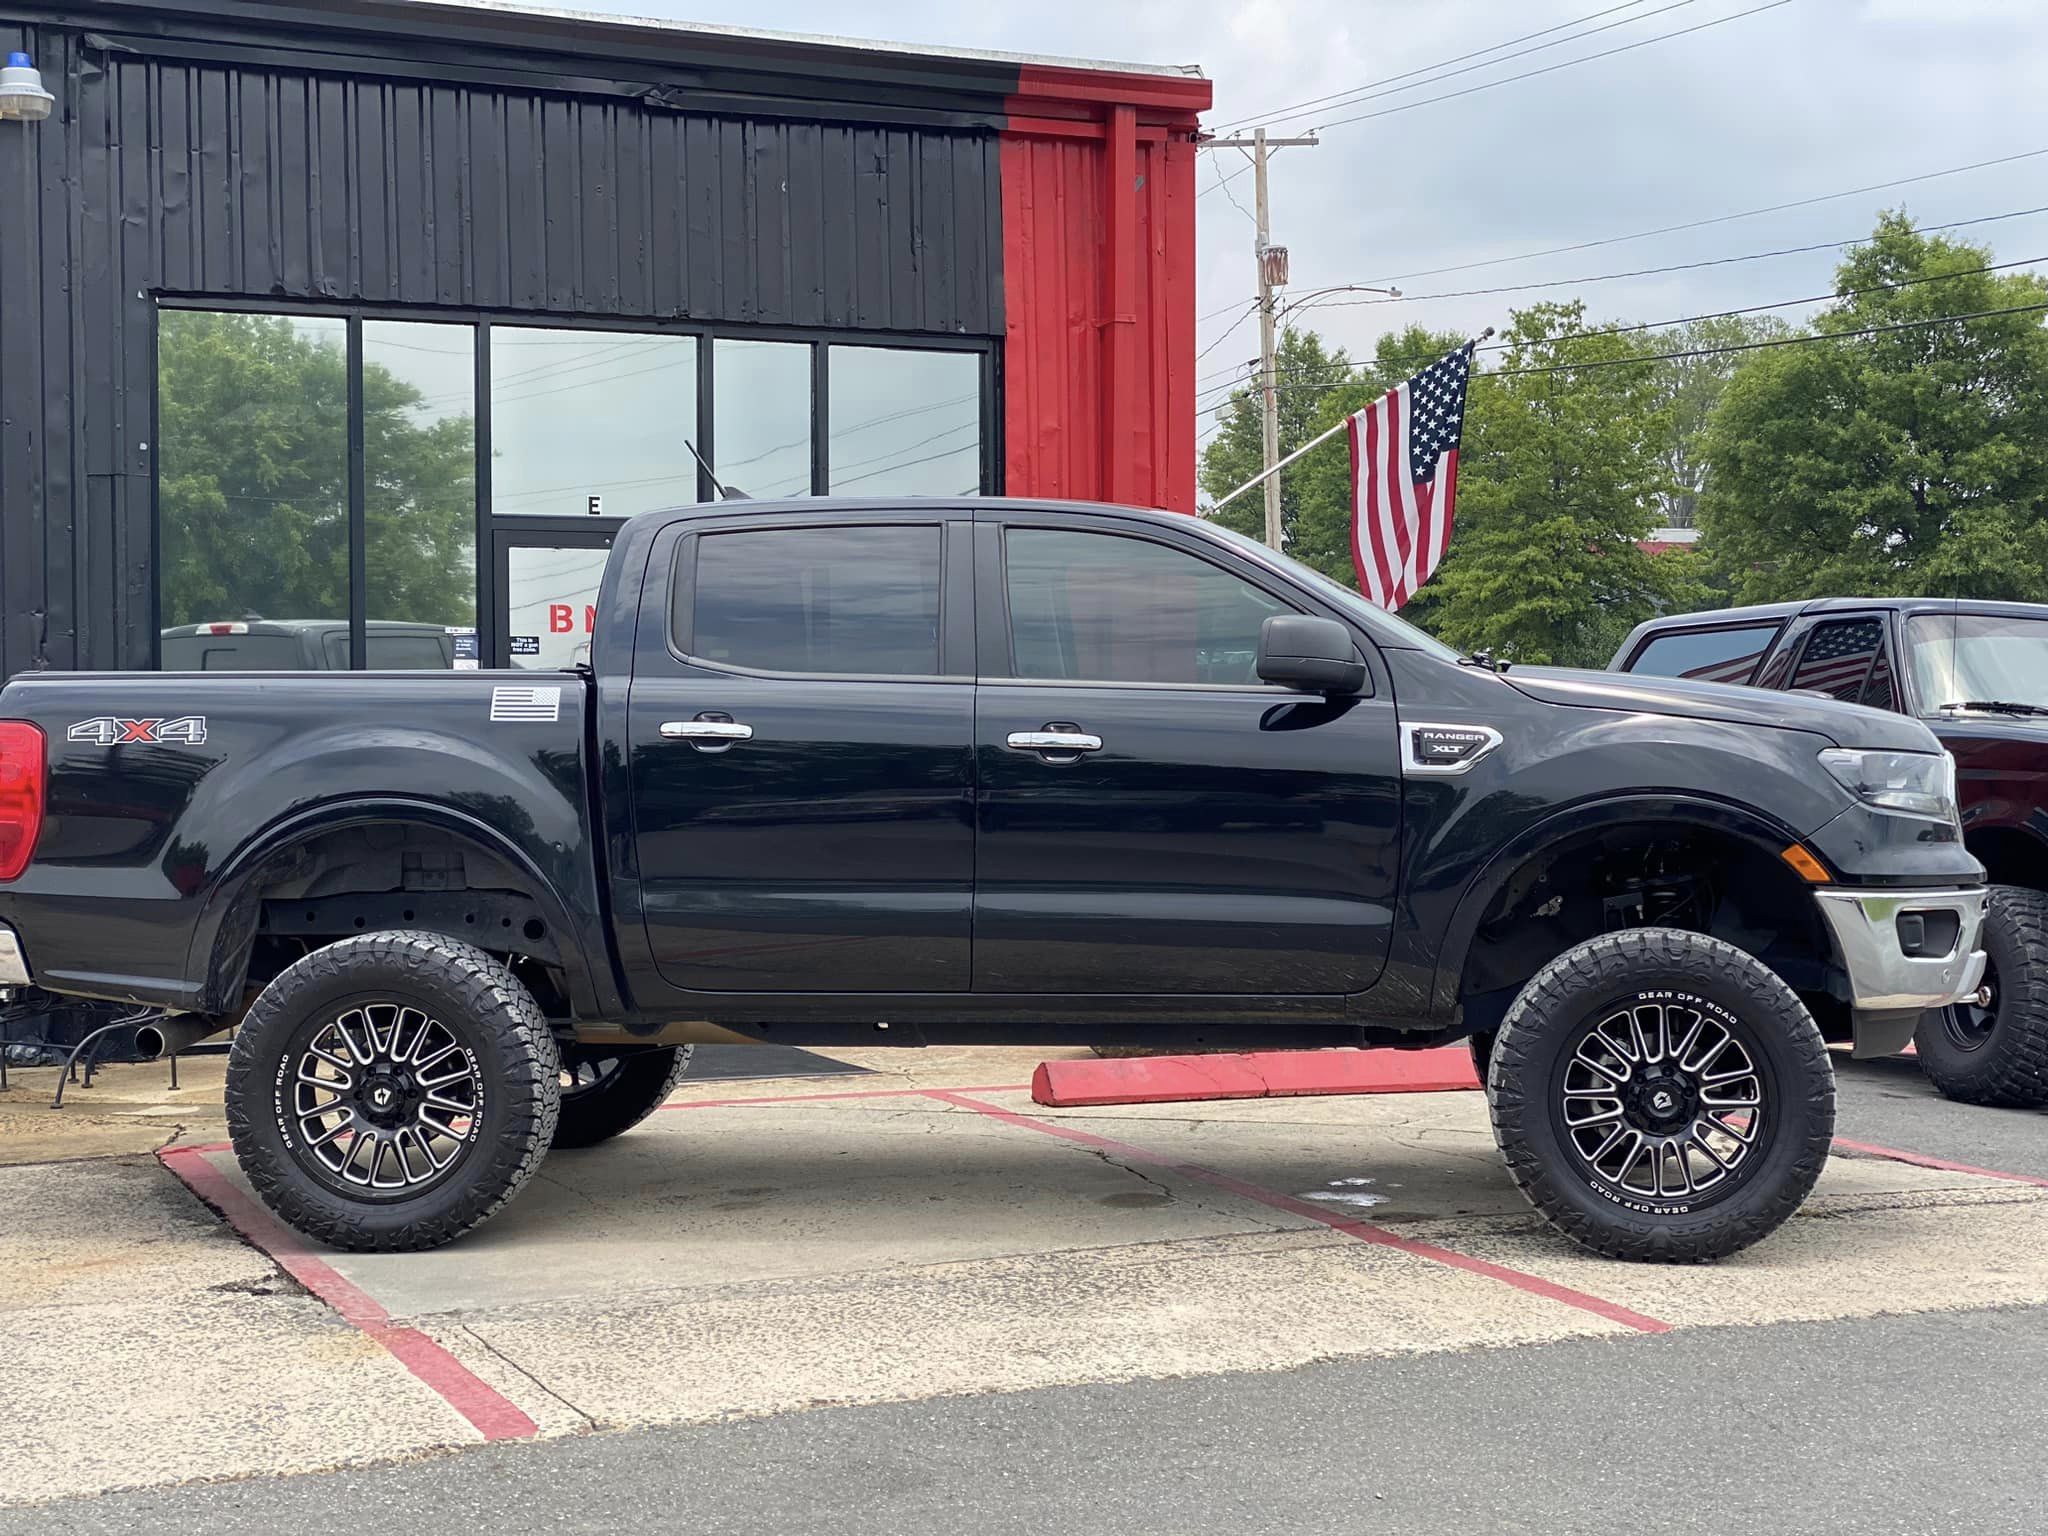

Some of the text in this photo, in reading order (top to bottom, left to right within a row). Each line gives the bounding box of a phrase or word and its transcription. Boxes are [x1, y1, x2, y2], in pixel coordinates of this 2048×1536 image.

[588, 496, 601, 515] E
[1424, 732, 1485, 741] RANGER
[1431, 744, 1464, 753] XLT
[1638, 991, 1738, 1024] GEAR OFF ROAD
[276, 1054, 289, 1086] ROAD
[466, 1048, 484, 1143] GEAR OFF ROAD
[278, 1118, 293, 1149] GEAR
[1590, 1180, 1621, 1203] ROAD
[1654, 1205, 1689, 1214] GEAR
